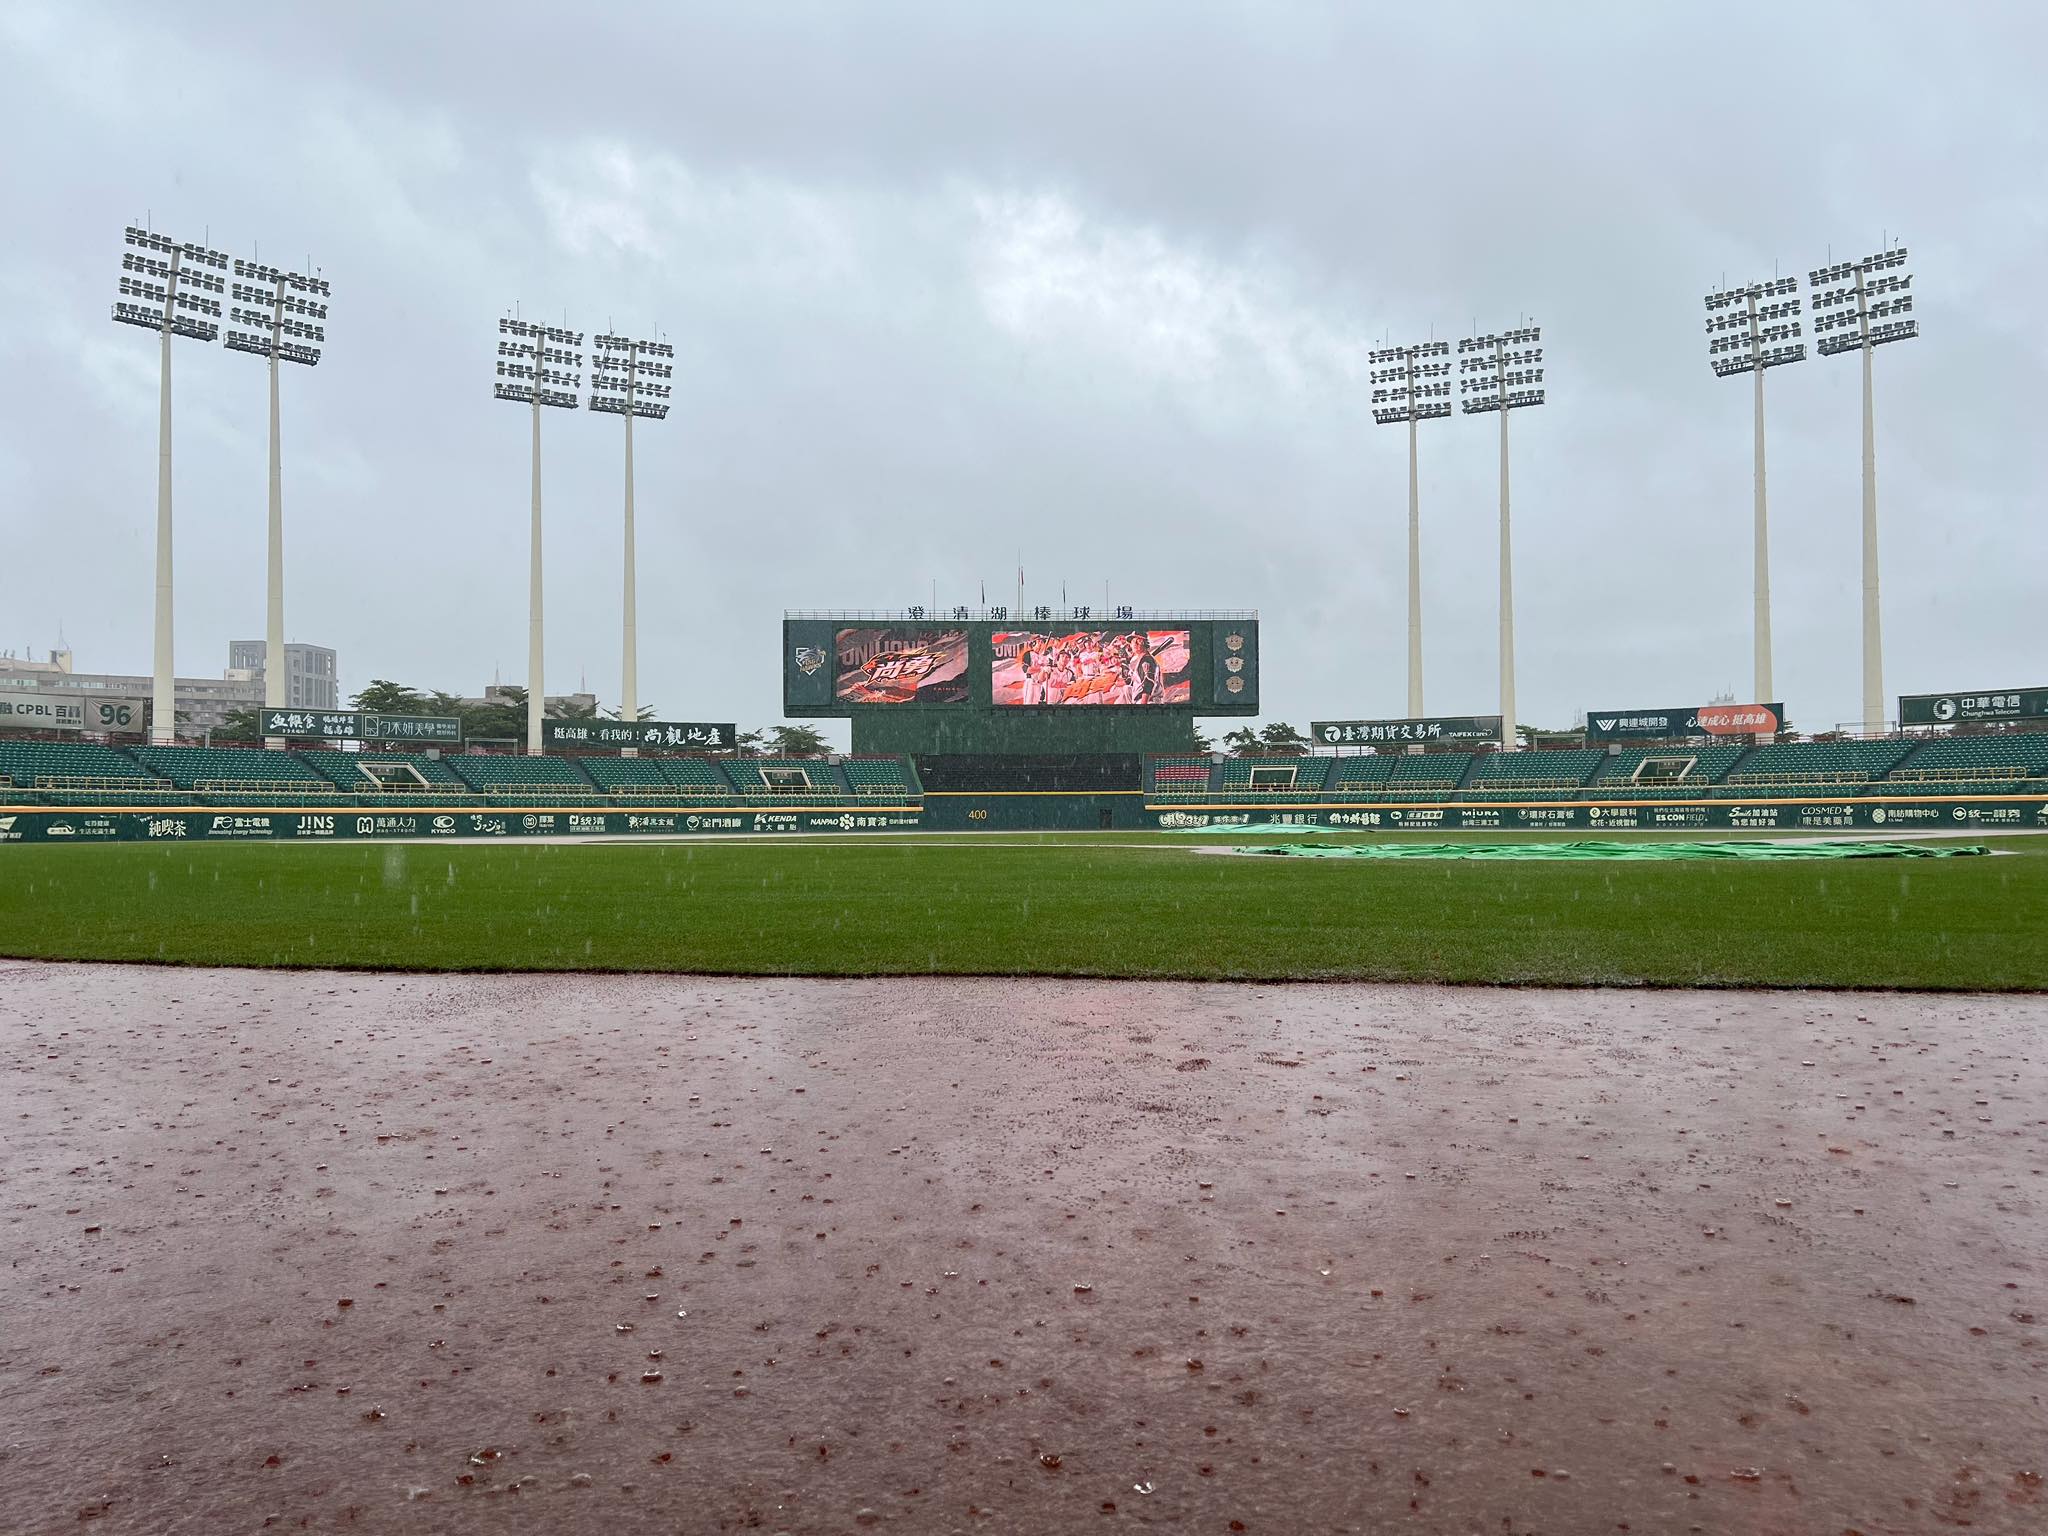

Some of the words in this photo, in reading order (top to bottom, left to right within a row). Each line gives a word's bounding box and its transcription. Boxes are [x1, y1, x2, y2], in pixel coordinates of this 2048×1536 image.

[908, 605, 1133, 620] 澄清湖棒球場
[872, 655, 935, 680] 尚勇
[1961, 695, 2020, 709] 中華電信
[17, 704, 52, 716] CPBL
[100, 704, 131, 725] 96
[1961, 710, 1994, 718] Chunghwa
[644, 726, 723, 747] 尚觀地產
[1342, 723, 1442, 741] 臺灣期貨交易所
[968, 809, 987, 820] 400
[1529, 810, 1575, 819] 環球石膏板
[1601, 808, 1637, 817] 大學眼科
[1752, 808, 1778, 817] 加油站
[1801, 806, 1842, 815] COSMED
[1887, 809, 1939, 818] 南紡購物中心
[1968, 809, 2021, 818] 統一證券
[234, 817, 270, 828] 富士電機
[376, 816, 416, 828] 萬通人力
[810, 818, 839, 826] NANPAO
[856, 816, 887, 827] 南寶漆
[1270, 813, 1318, 825] 兆豐銀行
[1686, 813, 1705, 821] FIELD
[1802, 816, 1854, 826] 康是美藥局
[148, 818, 187, 837] 純喫茶
[701, 818, 742, 828] 金門酒廠
